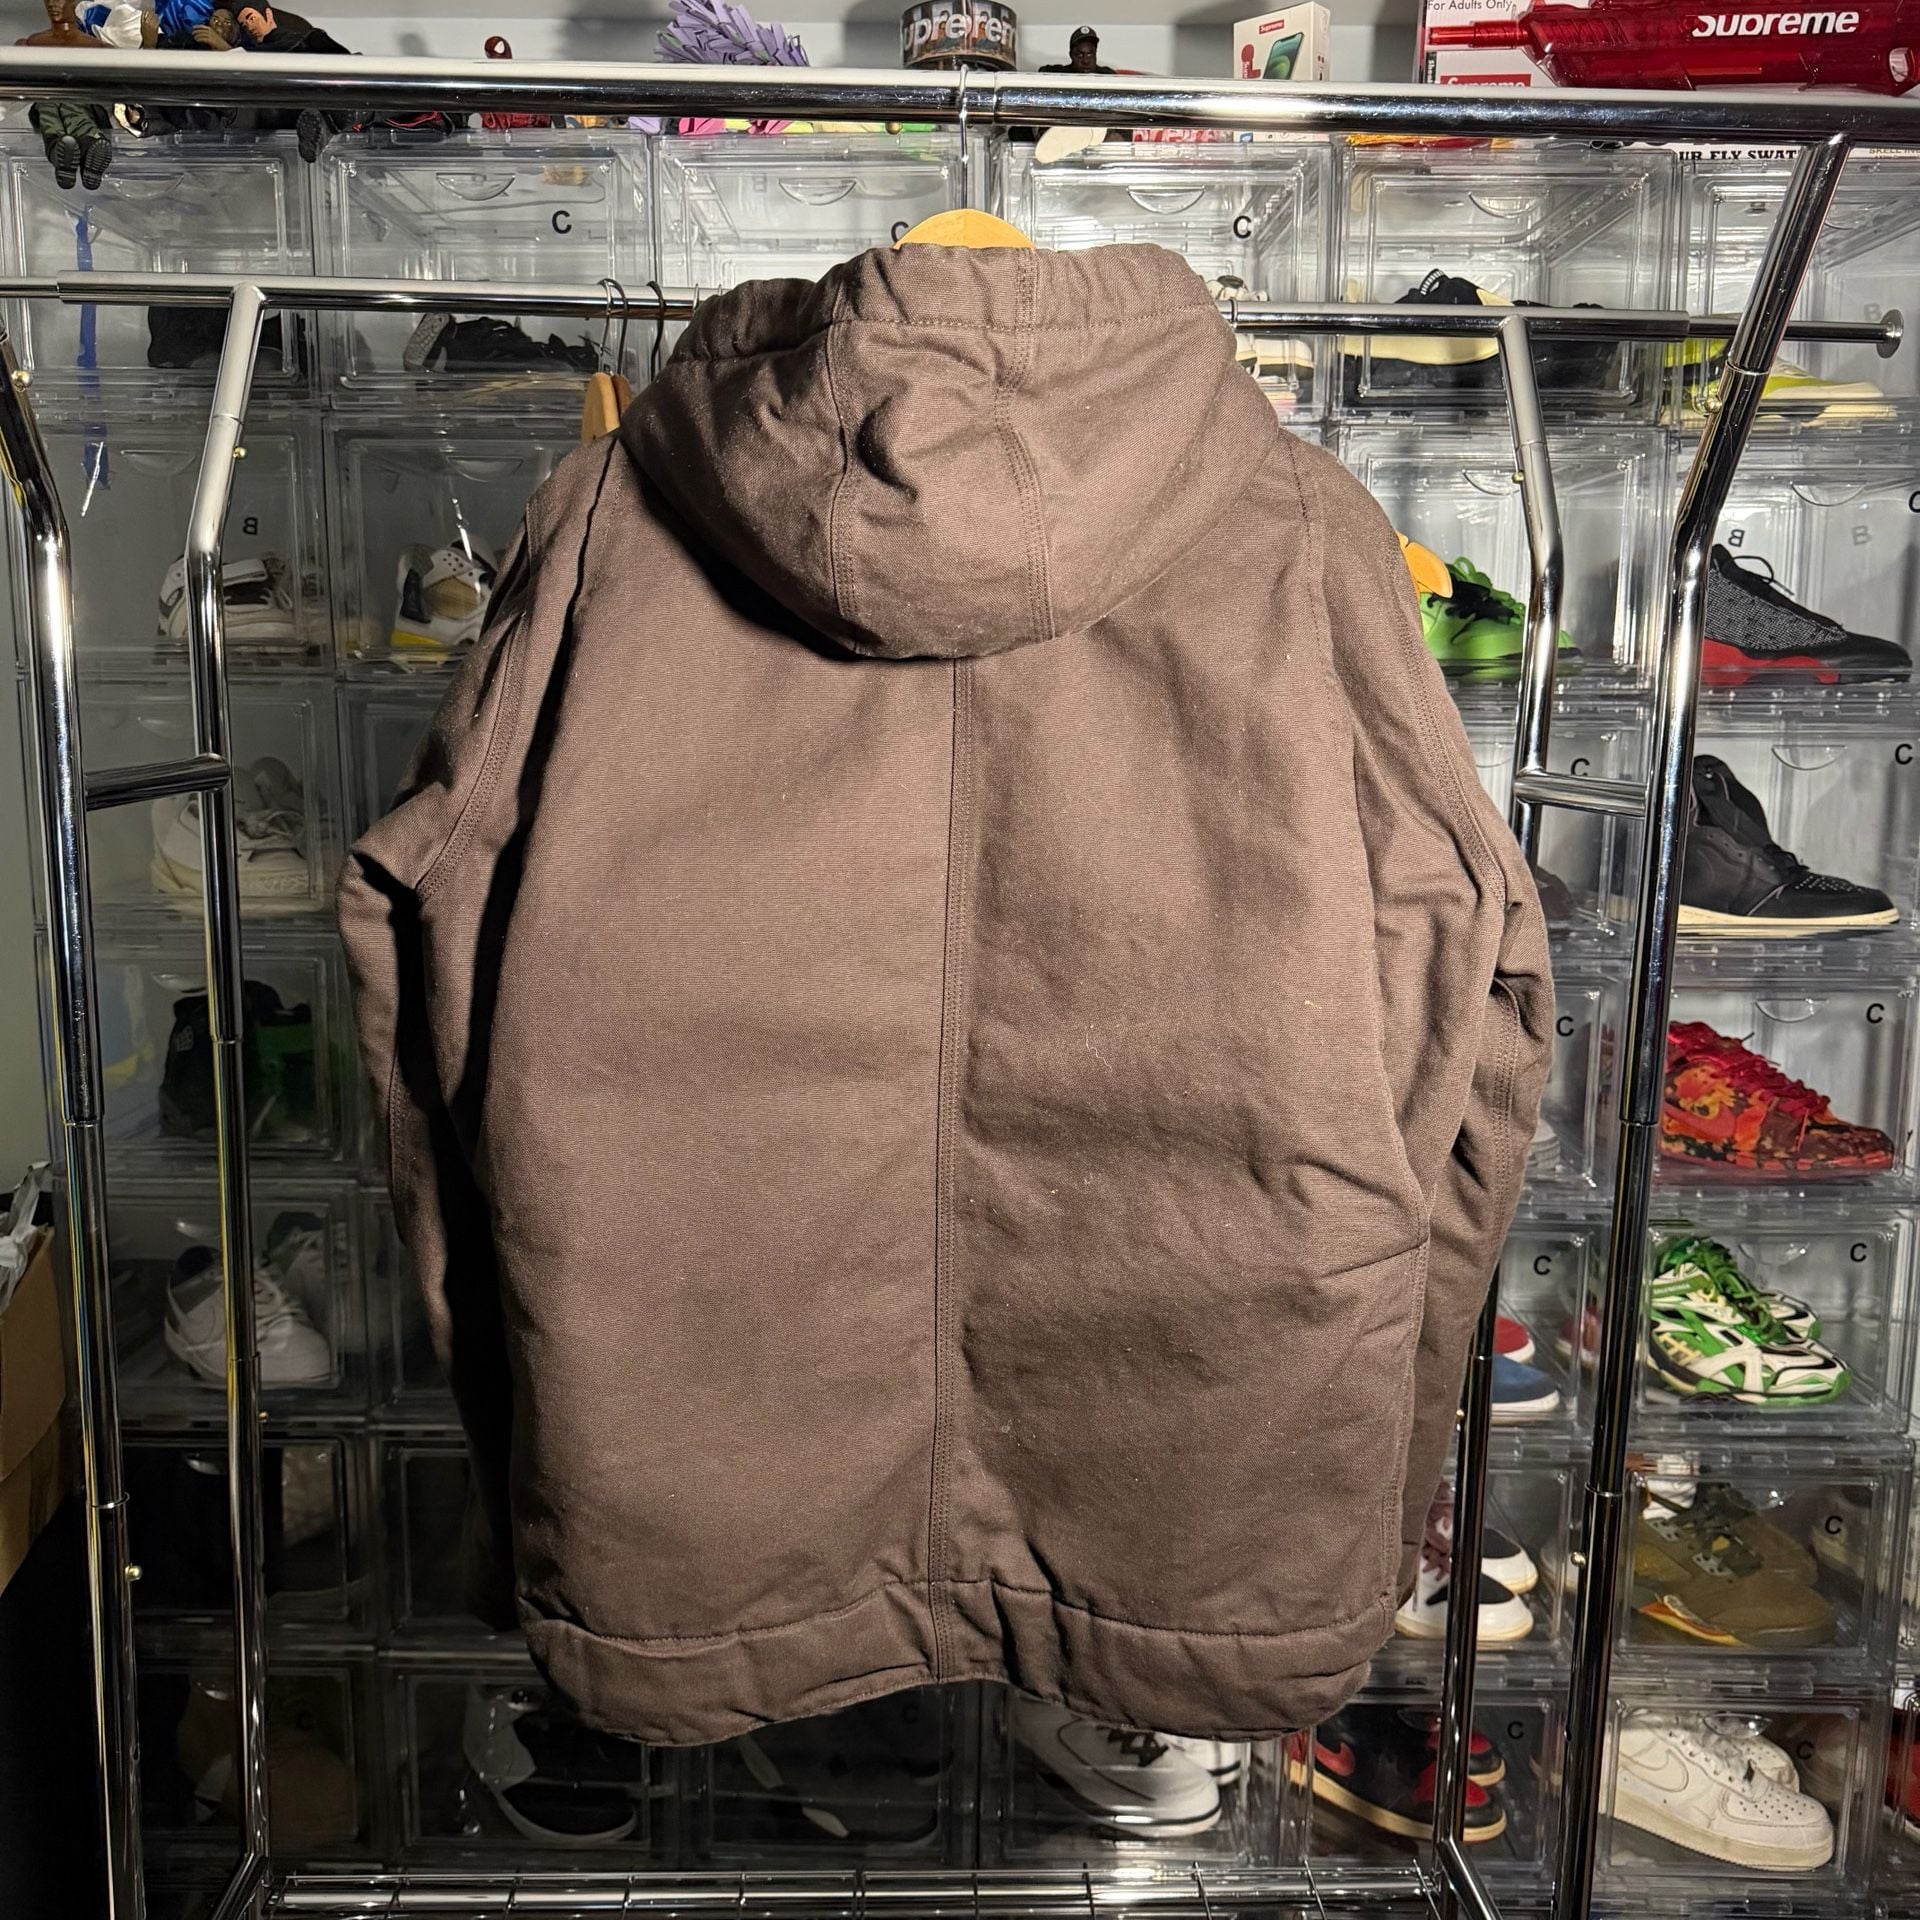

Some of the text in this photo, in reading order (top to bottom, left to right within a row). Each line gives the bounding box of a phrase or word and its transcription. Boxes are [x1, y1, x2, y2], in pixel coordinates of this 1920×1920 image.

[1448, 0, 1482, 10] Adults
[1486, 0, 1513, 12] Only
[1748, 149, 1800, 160] SWAT
[552, 209, 572, 235] C
[1233, 215, 1253, 239] C
[1895, 742, 1913, 766] C
[1866, 1002, 1885, 1024] C
[1555, 1015, 1575, 1037] C
[1850, 1242, 1868, 1263] C
[1533, 1254, 1552, 1276] C
[1824, 1514, 1844, 1535] C
[1507, 1720, 1525, 1740] C
